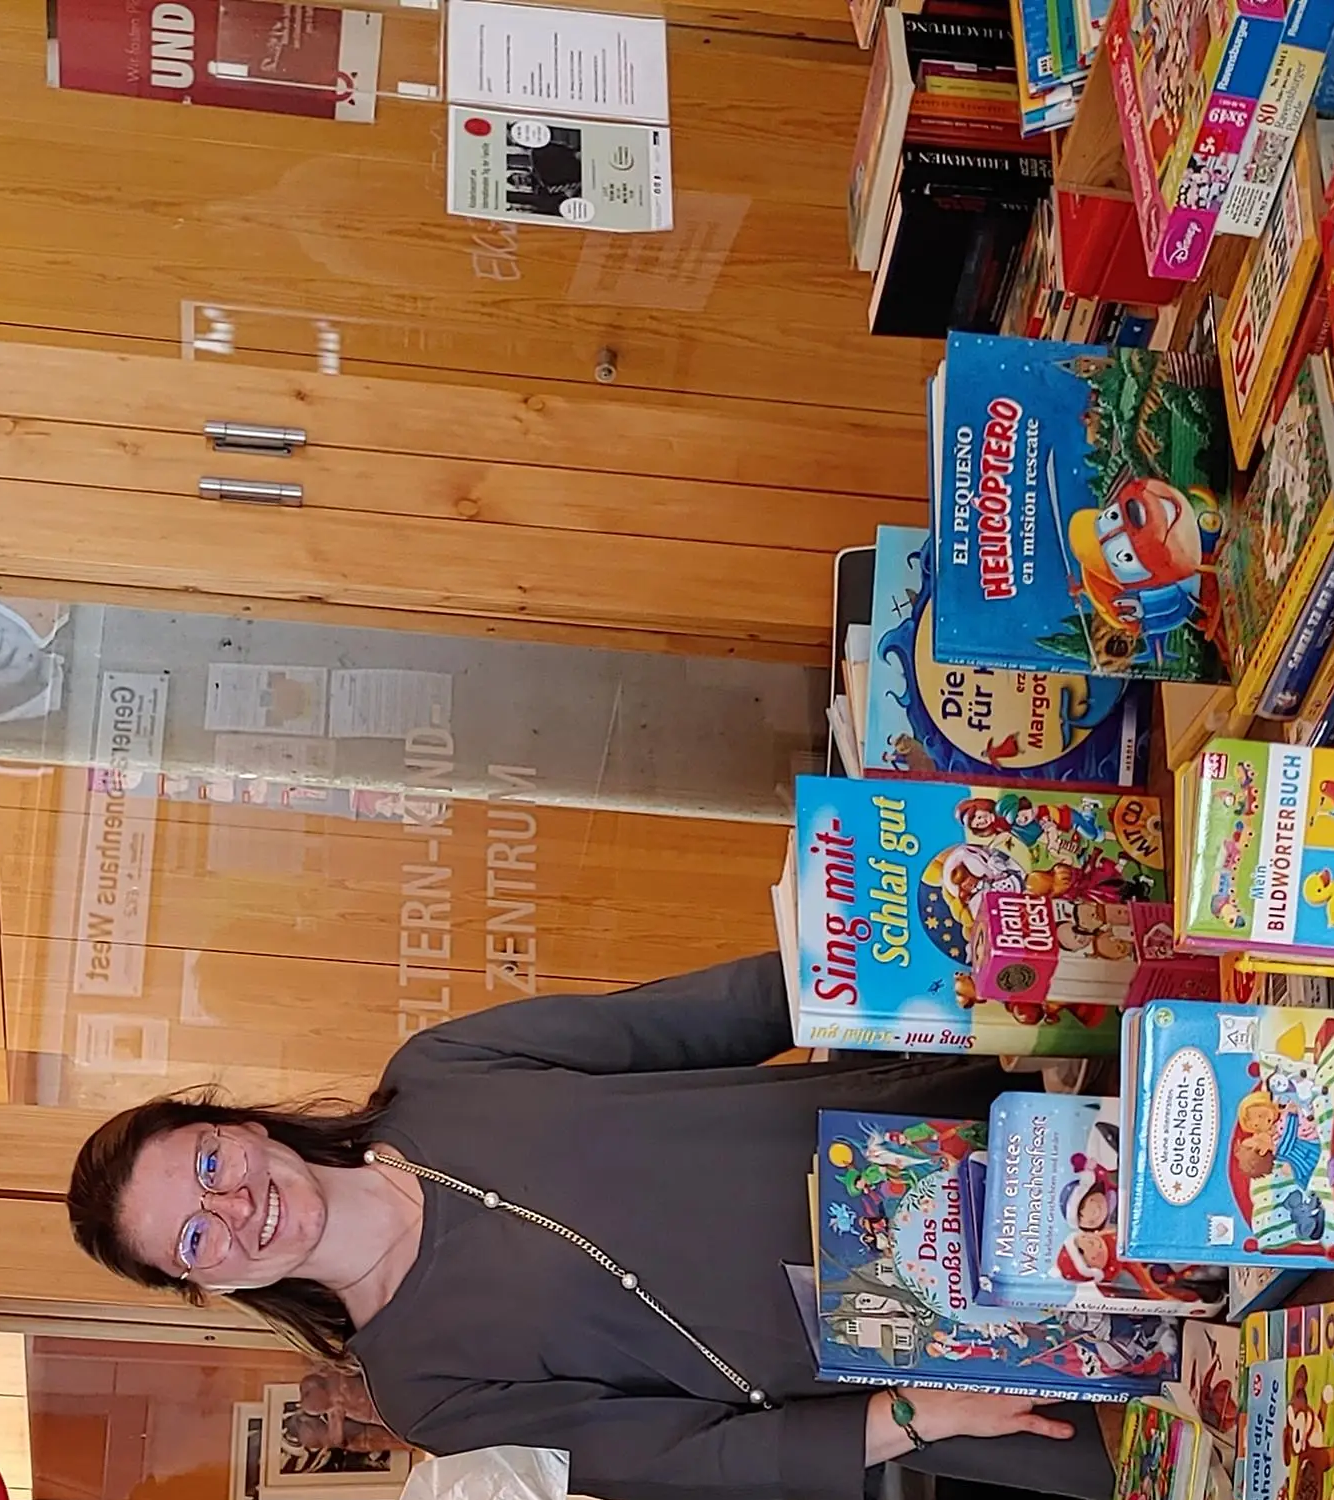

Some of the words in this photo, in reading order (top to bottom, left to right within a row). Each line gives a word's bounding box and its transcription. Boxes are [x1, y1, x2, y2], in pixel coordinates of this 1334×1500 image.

[151, 2, 196, 89] UND
[1216, 17, 1250, 92] Ravensburger
[1208, 106, 1249, 128] 3x49
[1255, 103, 1278, 127] 80
[1274, 60, 1307, 130] Ravensburger
[1285, 99, 1304, 132] Puzzle
[917, 151, 1010, 171] ERBARMEN
[1197, 136, 1216, 155] 5+
[1023, 417, 1040, 487] rescate
[950, 425, 975, 532] PEQUEÑO
[971, 396, 1023, 601] HELICÓPTERO
[1018, 491, 1039, 557] misión
[951, 537, 971, 566] EL
[1021, 561, 1037, 585] en
[940, 670, 966, 720] Die
[967, 684, 993, 732] für
[1027, 673, 1050, 750] Margot
[871, 794, 922, 851] gut
[1121, 800, 1144, 826] CD
[810, 818, 858, 902] mit-
[1122, 827, 1159, 858] MIT
[1268, 754, 1302, 932] BILDWÖRTERBUCH
[399, 703, 457, 1035] ELTERN-KIND-
[485, 763, 539, 995] ZENTRUM
[1250, 865, 1267, 900] Mein
[868, 857, 913, 967] Schlaf
[990, 896, 1027, 949] Brain
[1022, 895, 1055, 951] Quest
[813, 916, 866, 1004] Sing
[904, 1032, 935, 1048] mit
[938, 1030, 977, 1049] Sing
[1169, 1076, 1190, 1176] Gute-Nacht-
[1185, 1076, 1206, 1179] Geschichten
[1004, 1133, 1022, 1197] erstes
[941, 1177, 961, 1233] Buch
[1018, 1115, 1047, 1276] Weihnachtsfest
[918, 1218, 939, 1262] Das
[994, 1205, 1018, 1257] Mein
[942, 1240, 967, 1310] große
[836, 1374, 911, 1388] LACHEN
[912, 1378, 944, 1390] und
[944, 1381, 1001, 1395] LESEN
[1001, 1386, 1038, 1398] zum
[1039, 1388, 1079, 1401] Buch
[1079, 1390, 1130, 1403] große
[1251, 1412, 1264, 1443] die
[1250, 1452, 1261, 1493] mal
